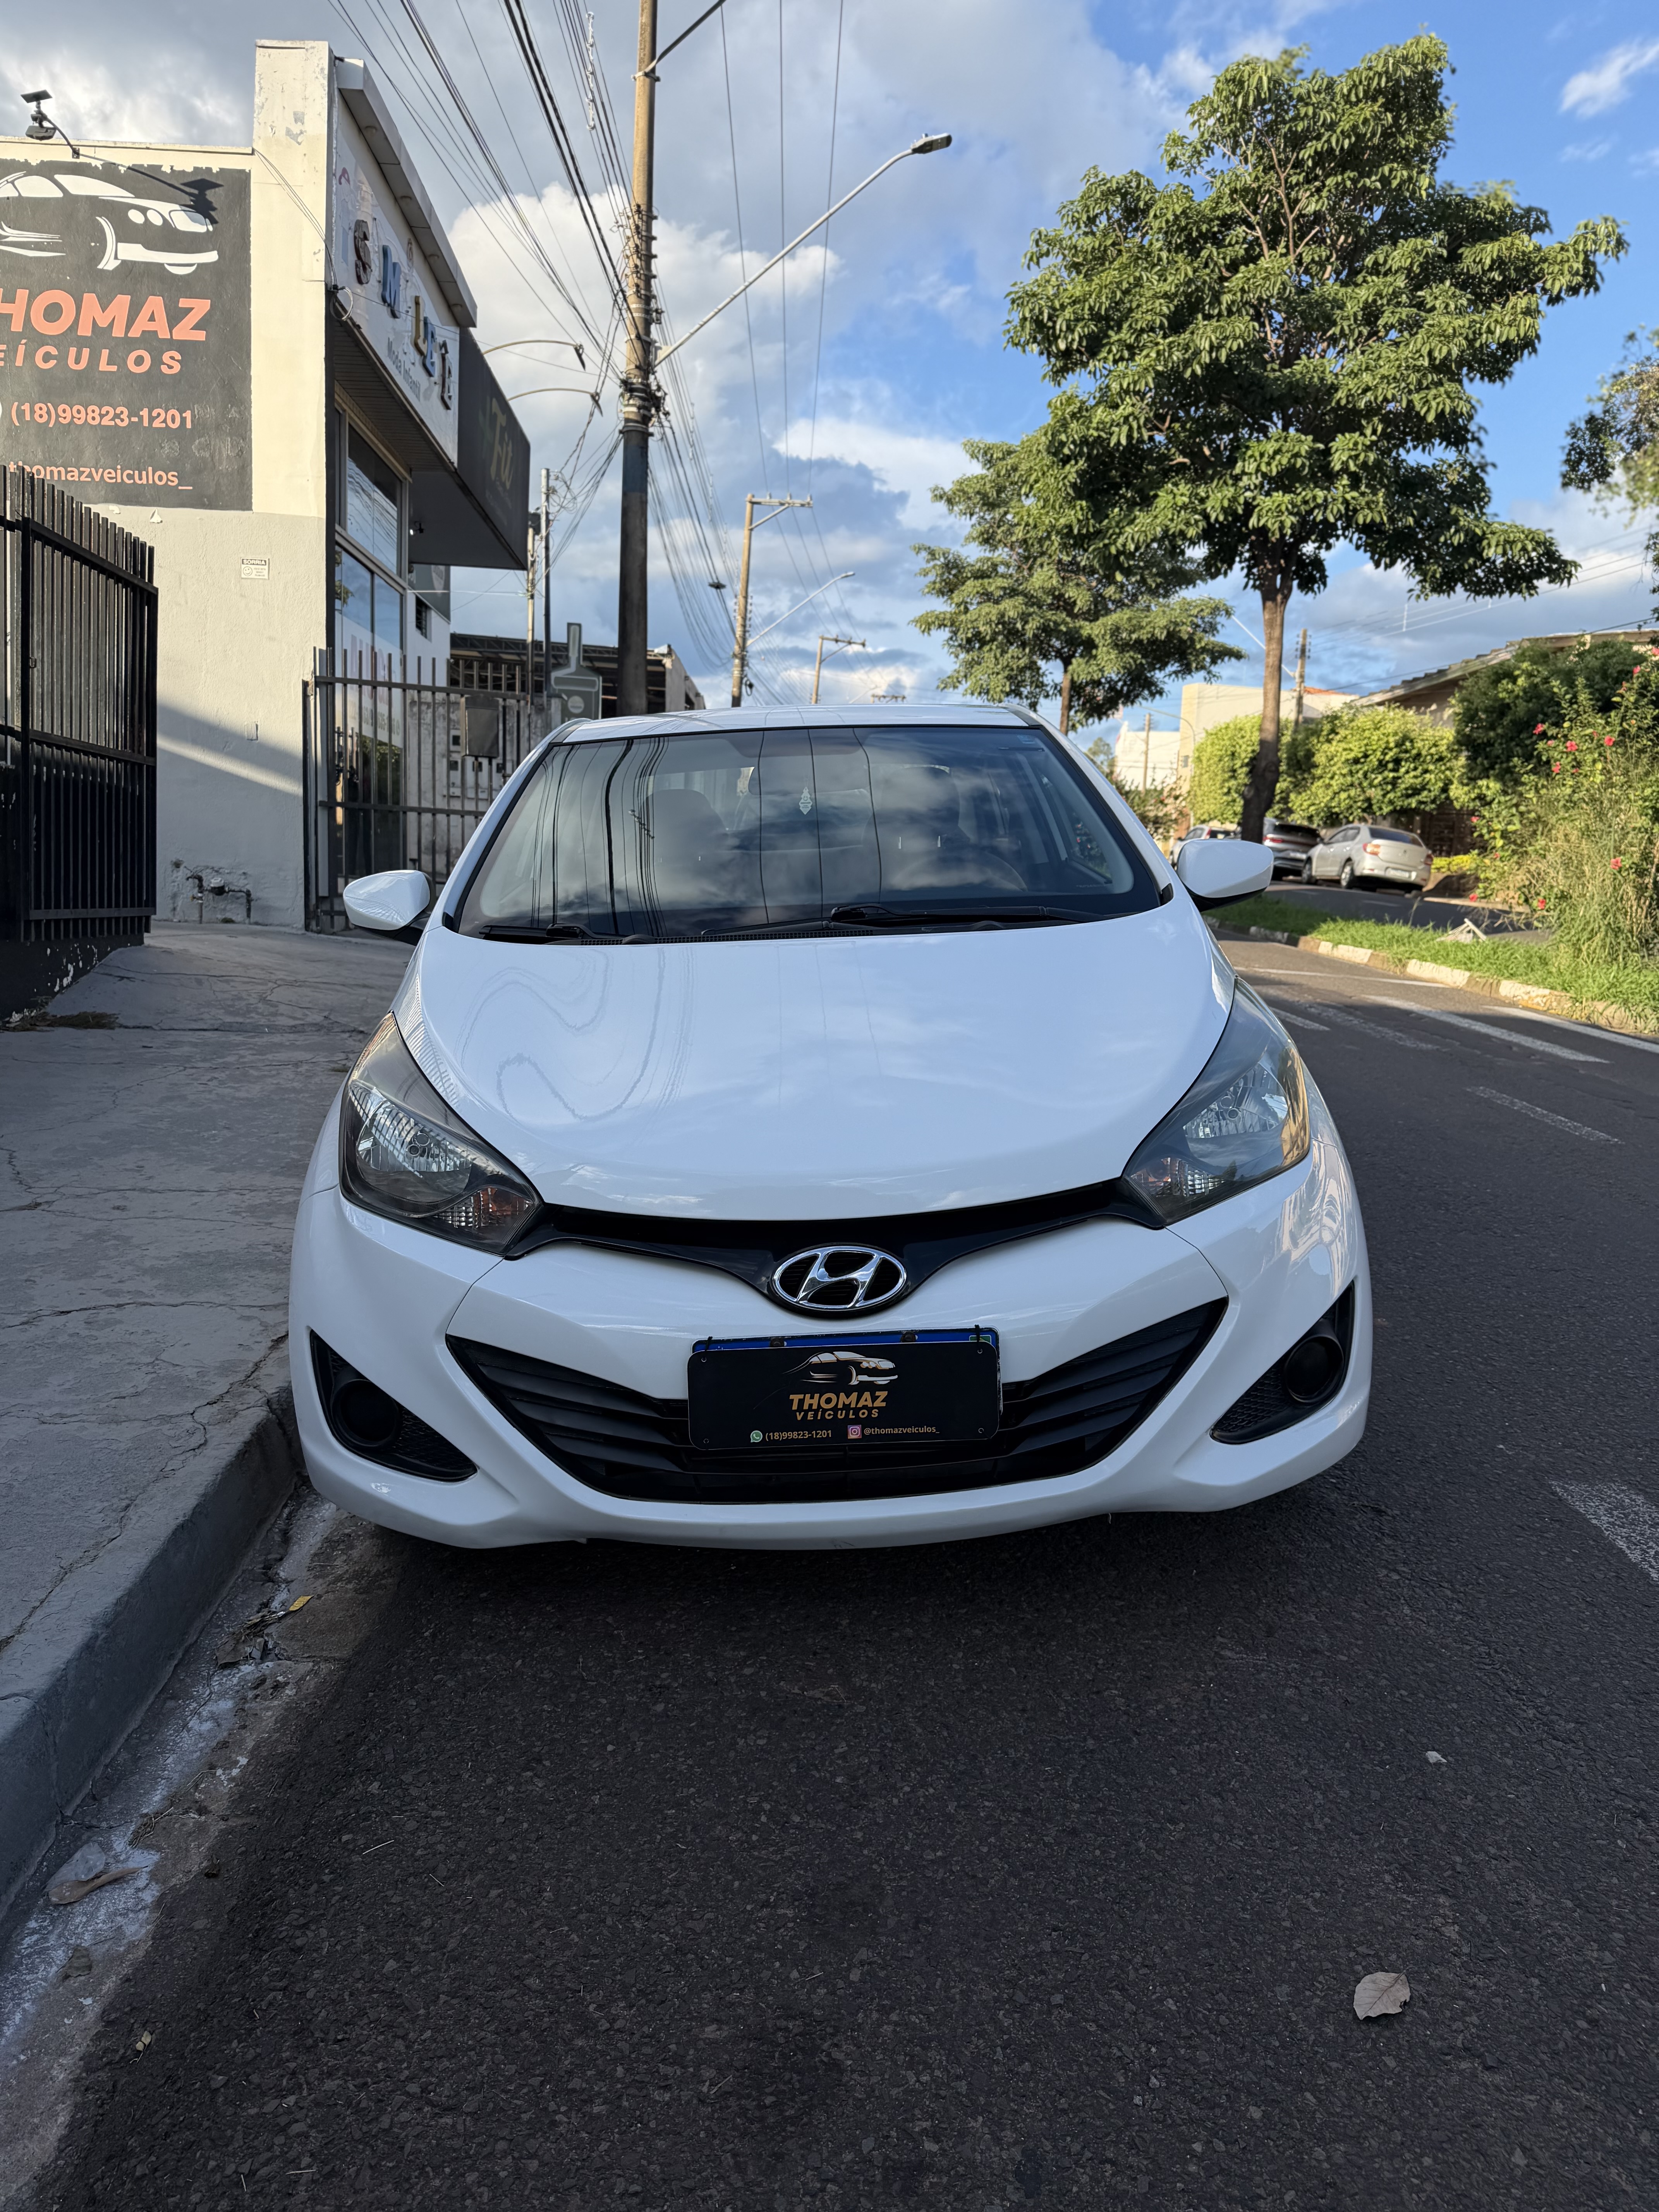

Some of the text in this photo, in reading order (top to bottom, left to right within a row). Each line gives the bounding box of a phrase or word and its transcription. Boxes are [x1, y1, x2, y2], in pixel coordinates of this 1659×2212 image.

[388, 337, 421, 402] Moda Infantil
[11, 402, 192, 429] (18)99823-1201
[789, 1391, 888, 1410] THOMAZ
[796, 1409, 879, 1420] VEÍCULOS
[765, 1425, 940, 1441] (18)99823-1201 @thomazveiculos_
